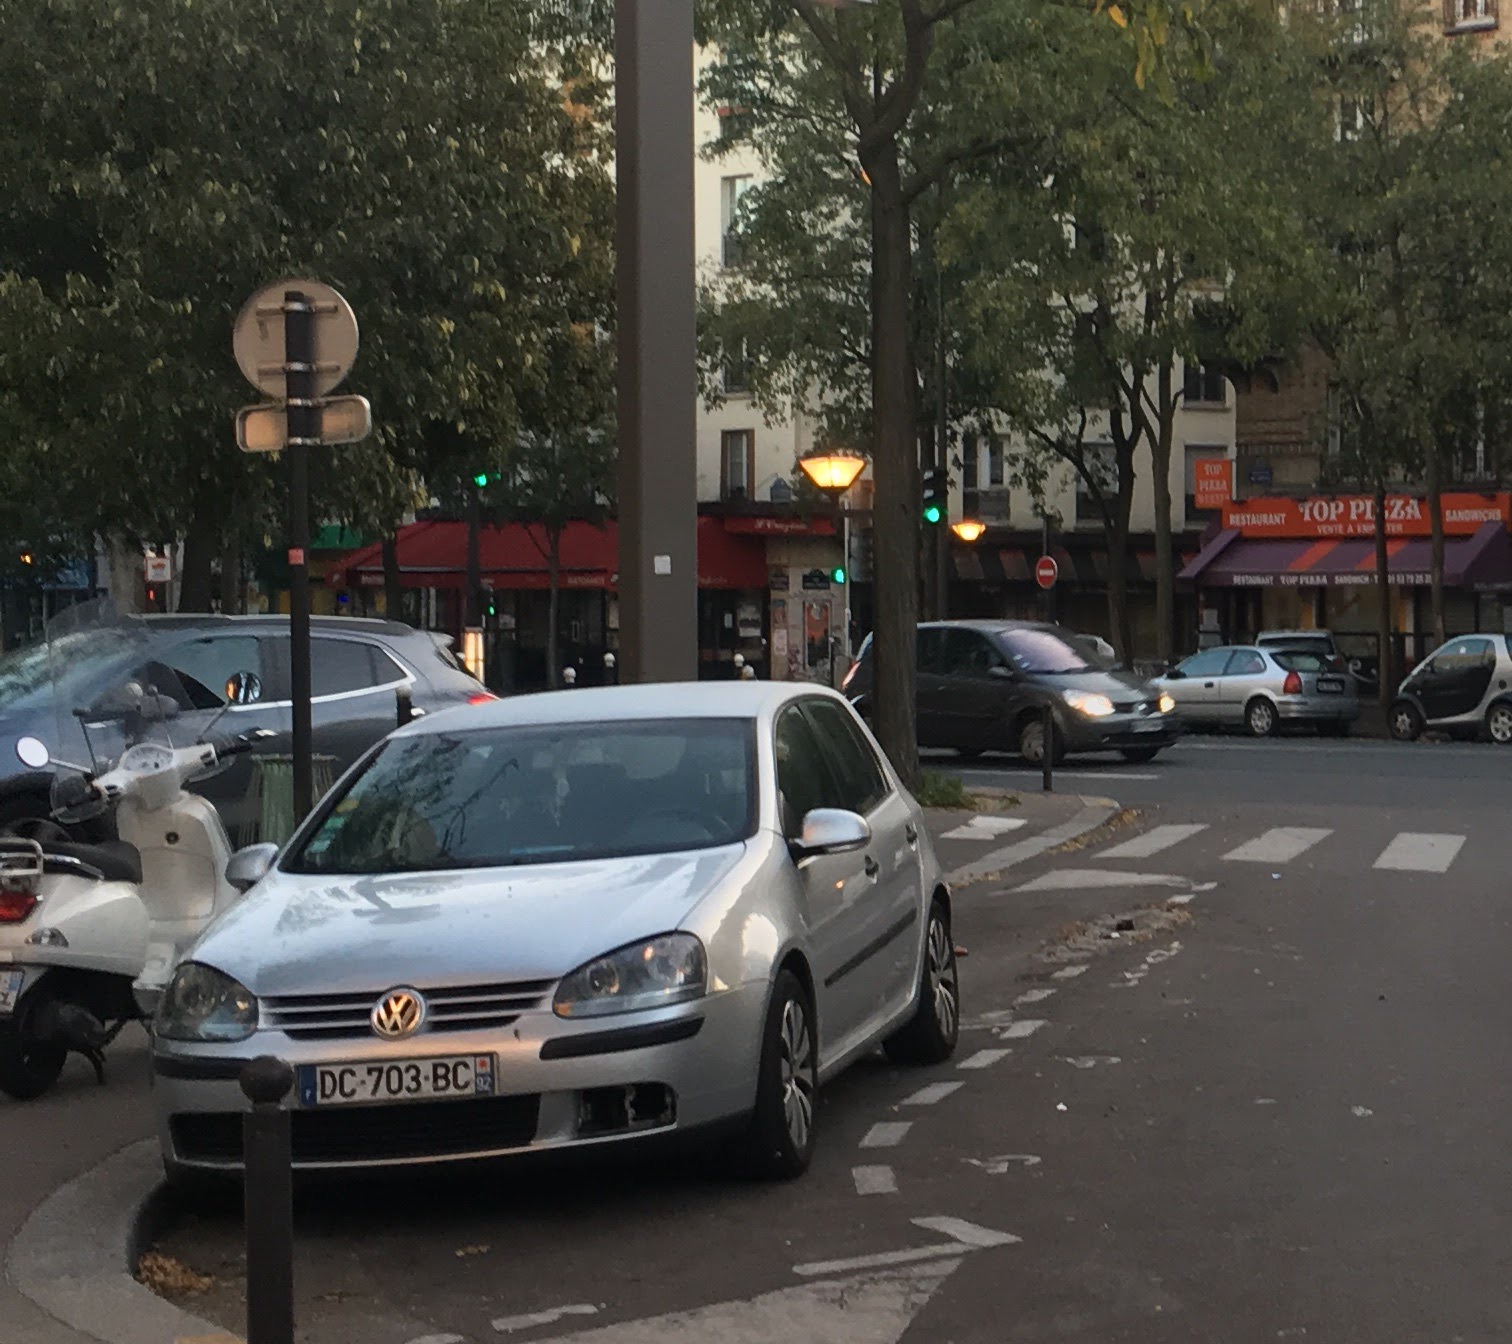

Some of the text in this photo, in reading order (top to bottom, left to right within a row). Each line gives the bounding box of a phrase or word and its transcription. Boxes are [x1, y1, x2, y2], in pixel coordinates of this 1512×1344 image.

[1204, 463, 1222, 475] TOP
[1299, 498, 1422, 521] TOP PIZA
[1229, 513, 1286, 526] RESTAURANT
[319, 1060, 472, 1099] DC-703-BC
[476, 1075, 492, 1092] 92
